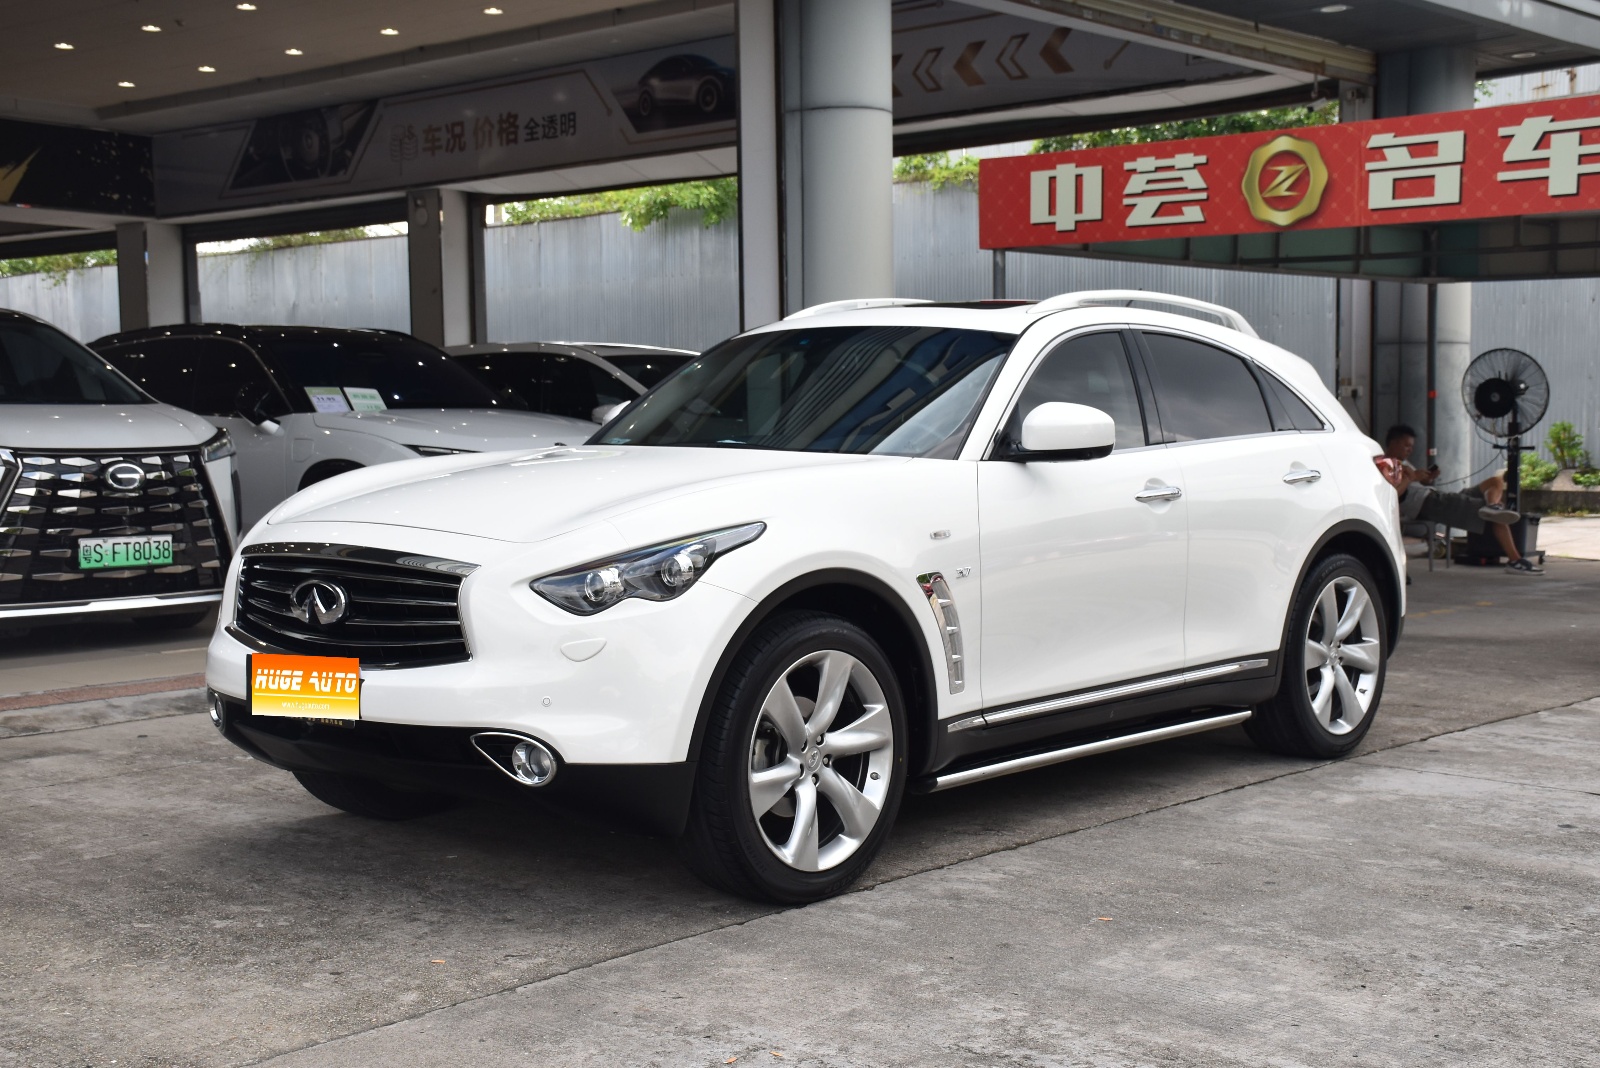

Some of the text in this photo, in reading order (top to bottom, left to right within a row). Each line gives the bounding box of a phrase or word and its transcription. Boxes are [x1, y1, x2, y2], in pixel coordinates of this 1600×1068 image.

[422, 111, 577, 157] 车况 价格 全透明
[1365, 115, 1600, 210] 名车
